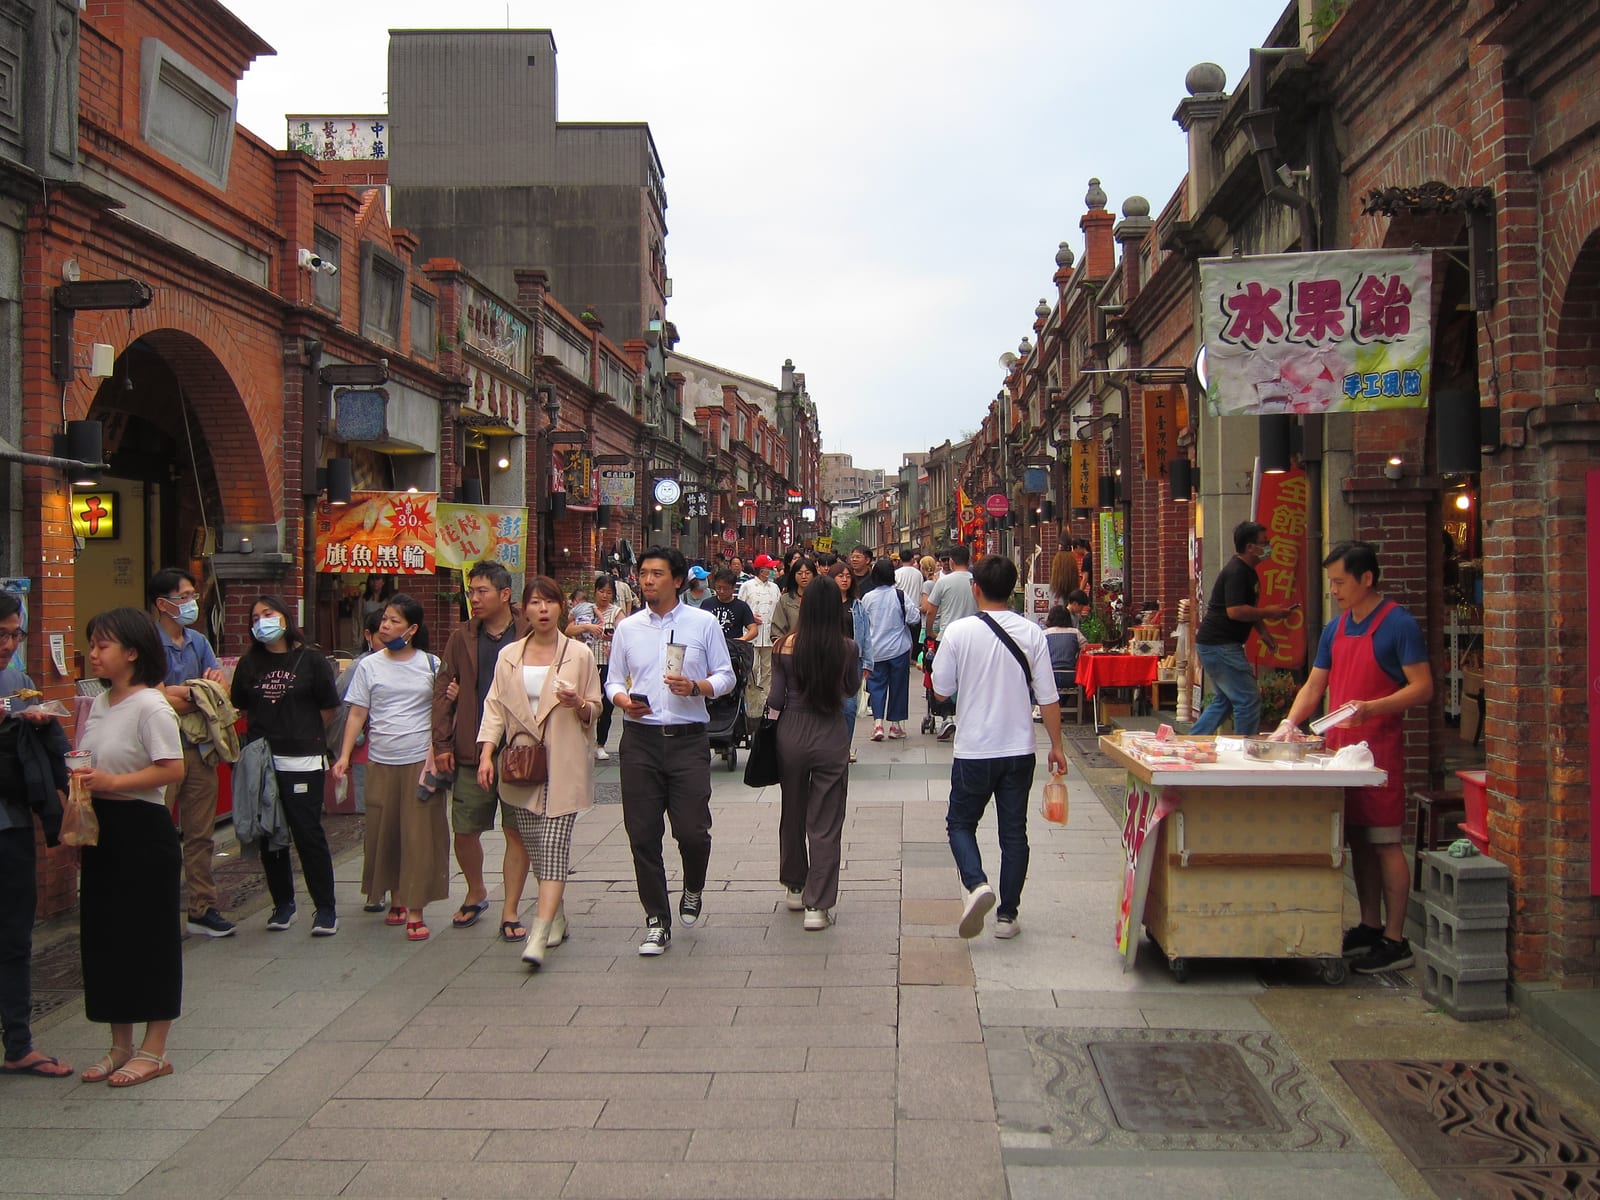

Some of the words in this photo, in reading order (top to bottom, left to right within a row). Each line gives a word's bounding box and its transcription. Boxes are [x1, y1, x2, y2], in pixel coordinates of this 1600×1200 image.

[370, 122, 385, 159] 中藥
[1220, 273, 1412, 350] 水果飴
[1342, 369, 1422, 399] 手工現做
[325, 542, 426, 570] 旗魚黑輪
[496, 515, 522, 567] 澎湖
[264, 670, 297, 682] ATURE
